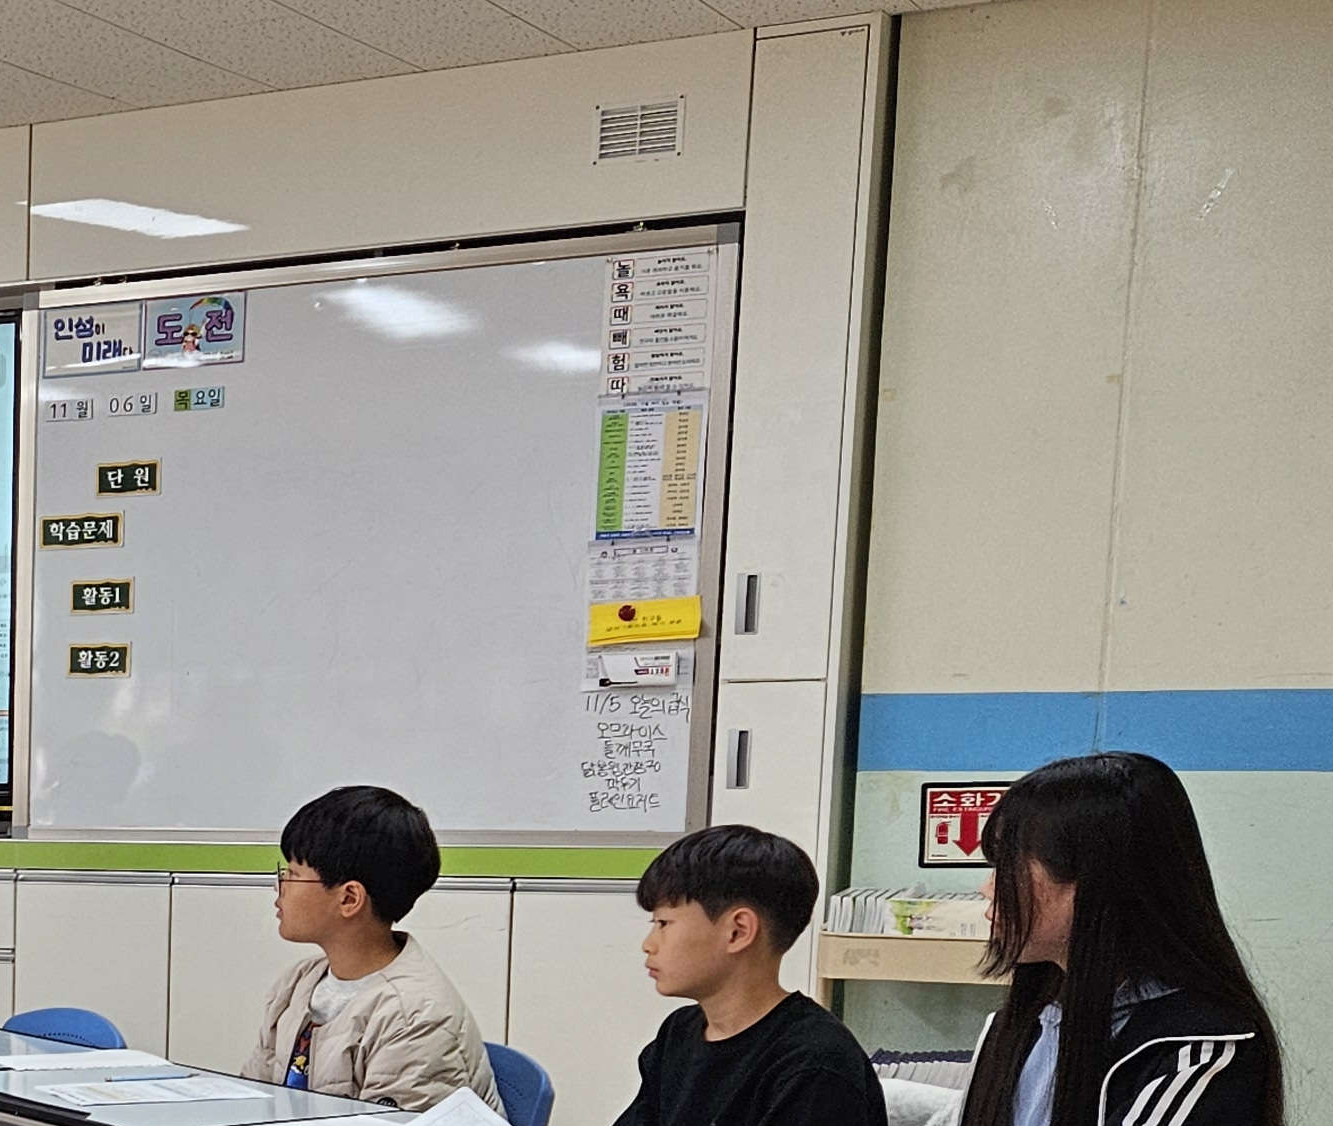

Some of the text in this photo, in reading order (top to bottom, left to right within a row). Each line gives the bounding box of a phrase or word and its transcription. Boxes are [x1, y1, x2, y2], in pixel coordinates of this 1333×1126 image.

[616, 261, 631, 278] 놀
[615, 284, 630, 299] 욕
[614, 306, 629, 321] 때
[54, 316, 105, 342] 인성이
[612, 353, 625, 371] 험
[49, 519, 113, 541] 학습문제
[82, 586, 121, 606] 활동1
[78, 650, 120, 669] 활동2
[586, 692, 690, 723] 11/5 오늘의 급식
[597, 722, 668, 741] 오므라이스
[605, 777, 641, 792] 깍두기
